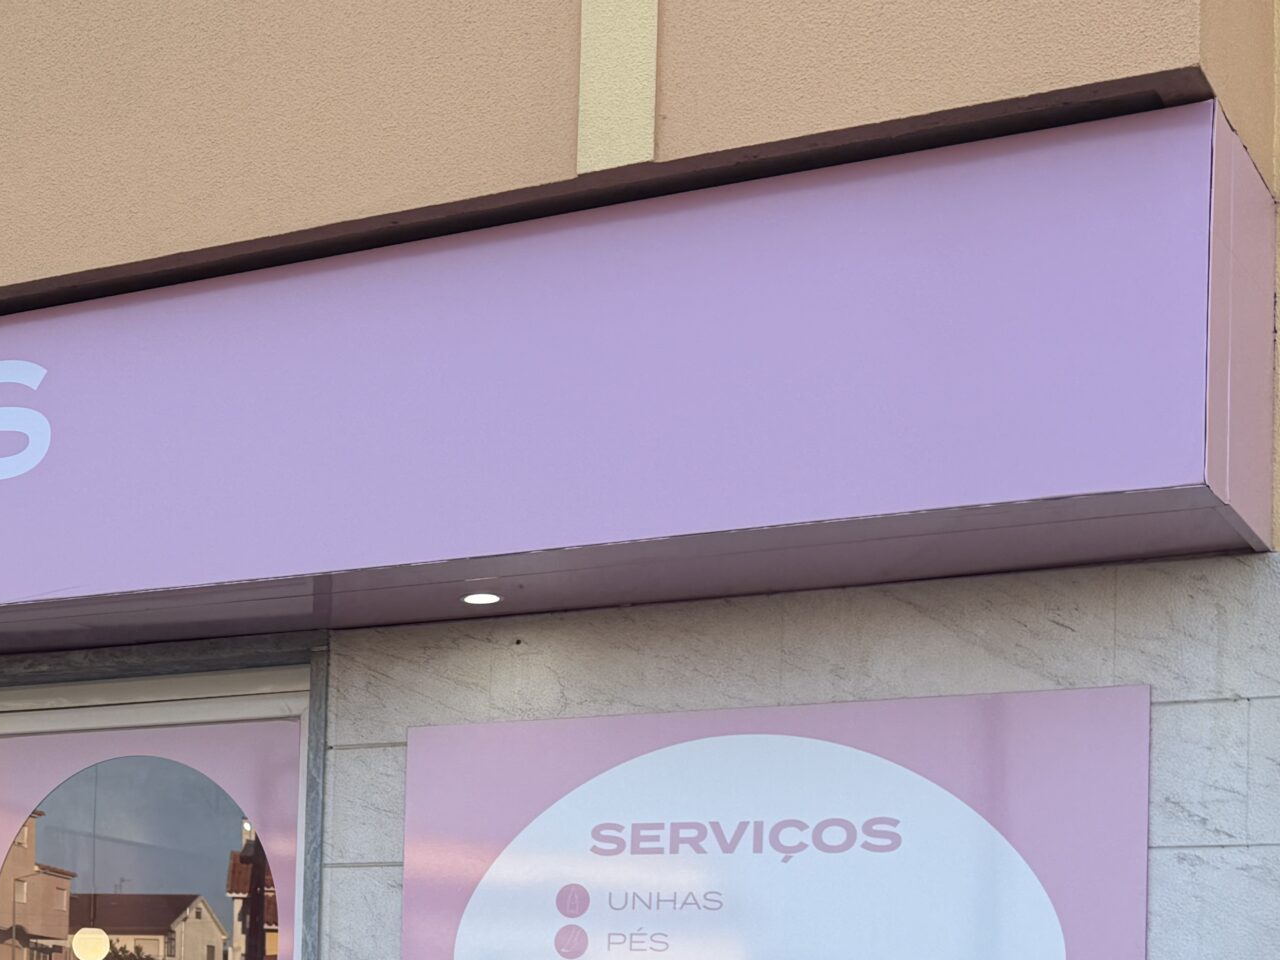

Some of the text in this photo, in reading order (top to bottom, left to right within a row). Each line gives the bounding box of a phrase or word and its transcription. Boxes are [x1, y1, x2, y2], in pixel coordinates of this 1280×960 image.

[589, 816, 903, 864] SERVIÇOS
[608, 890, 724, 911] UNHAS
[606, 927, 669, 952] PÉS
